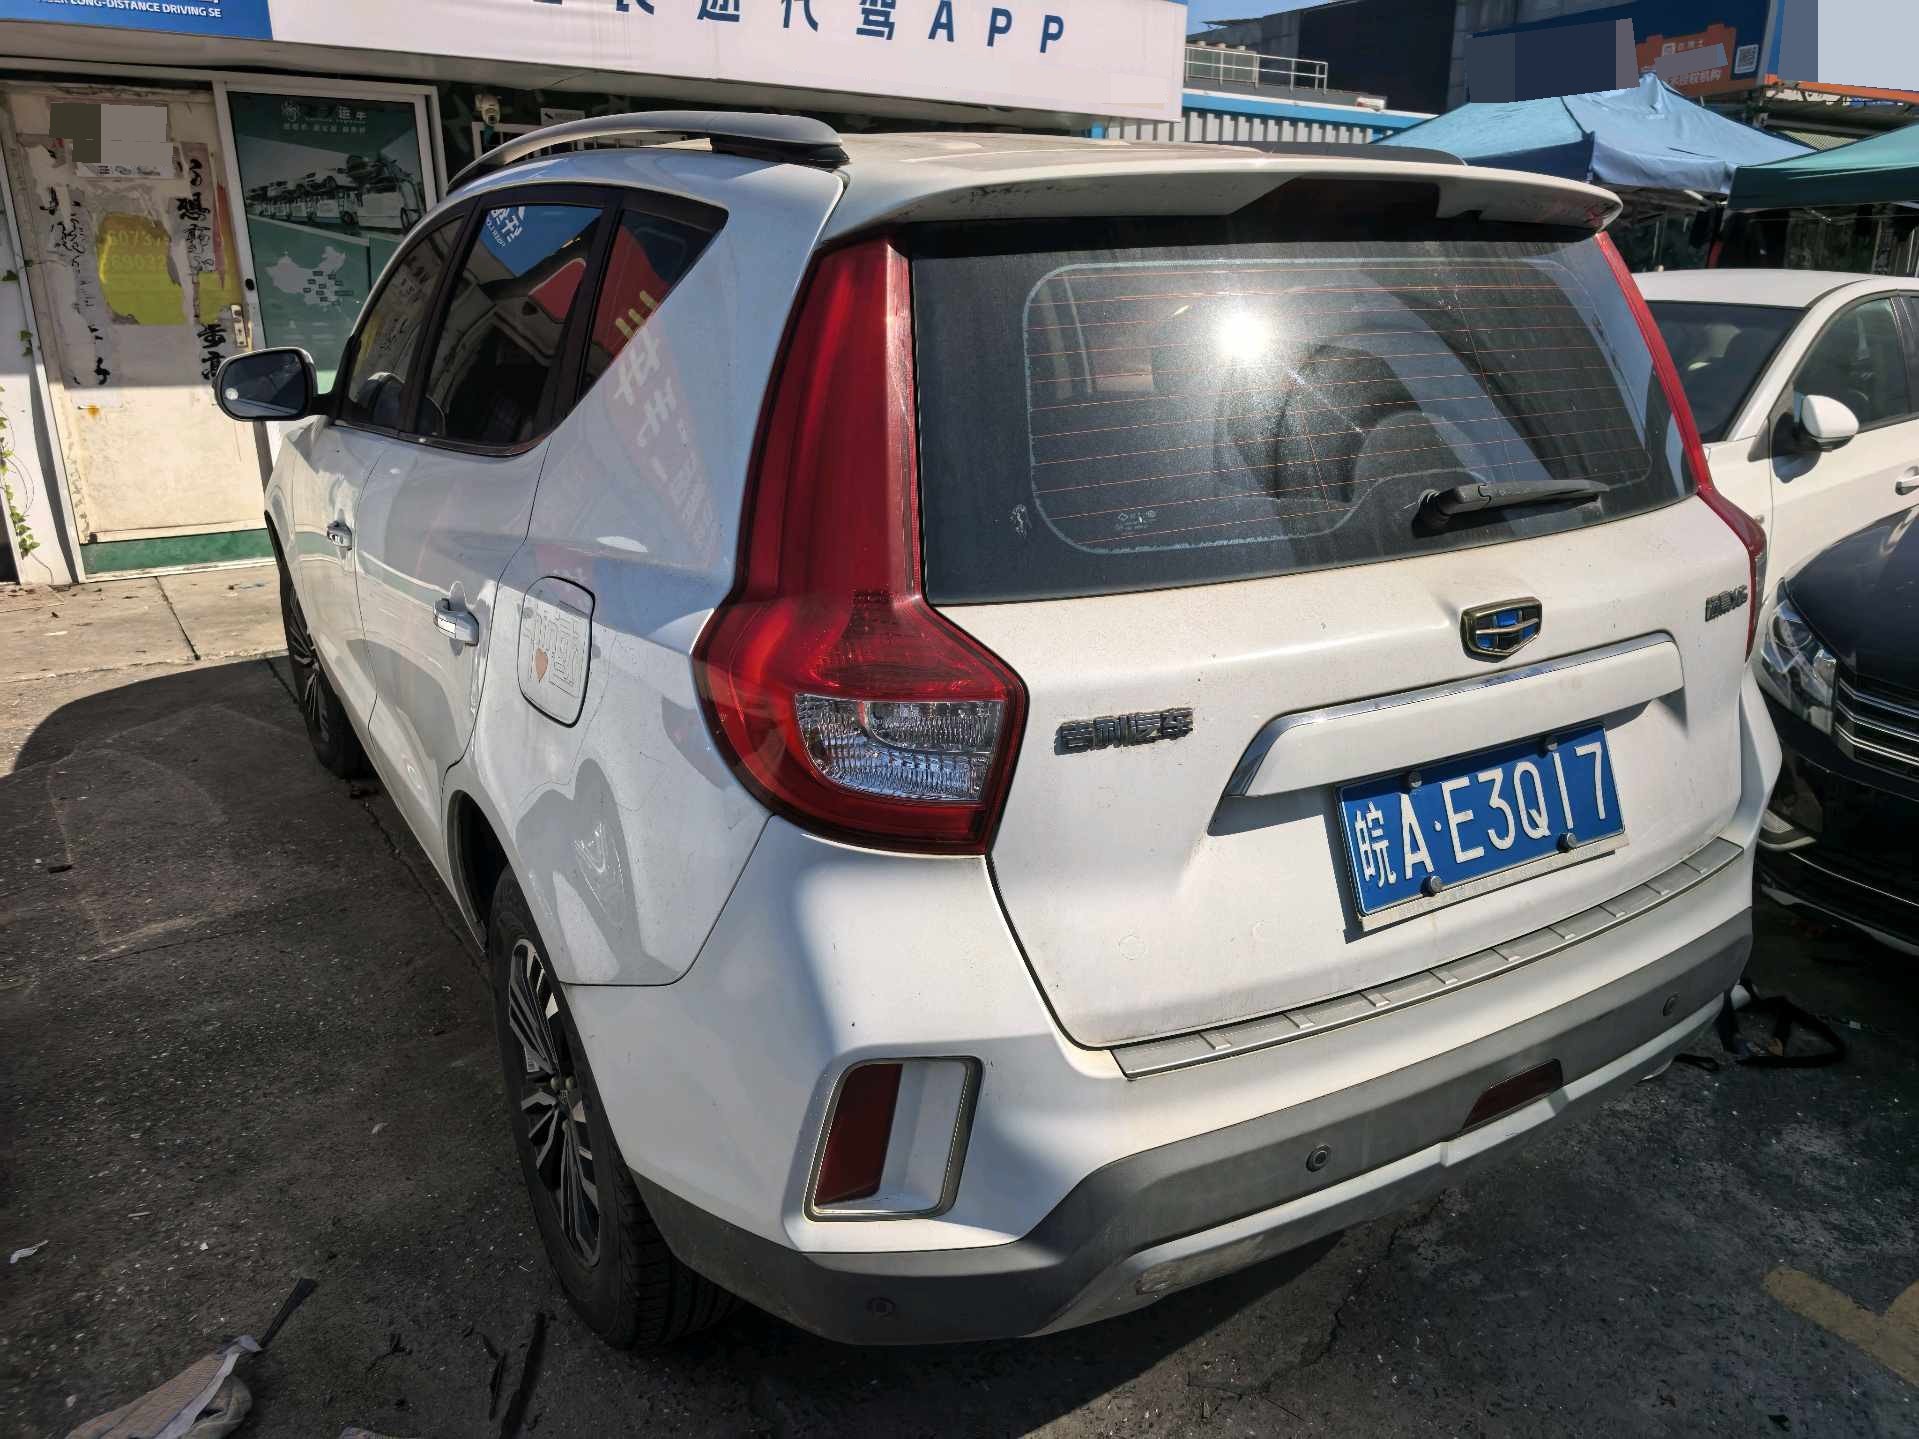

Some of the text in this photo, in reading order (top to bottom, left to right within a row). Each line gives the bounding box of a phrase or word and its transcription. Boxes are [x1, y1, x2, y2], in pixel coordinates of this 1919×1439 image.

[162, 3, 207, 16] DRIVING
[208, 7, 222, 17] SE
[1053, 707, 1194, 756] 吉利汽车
